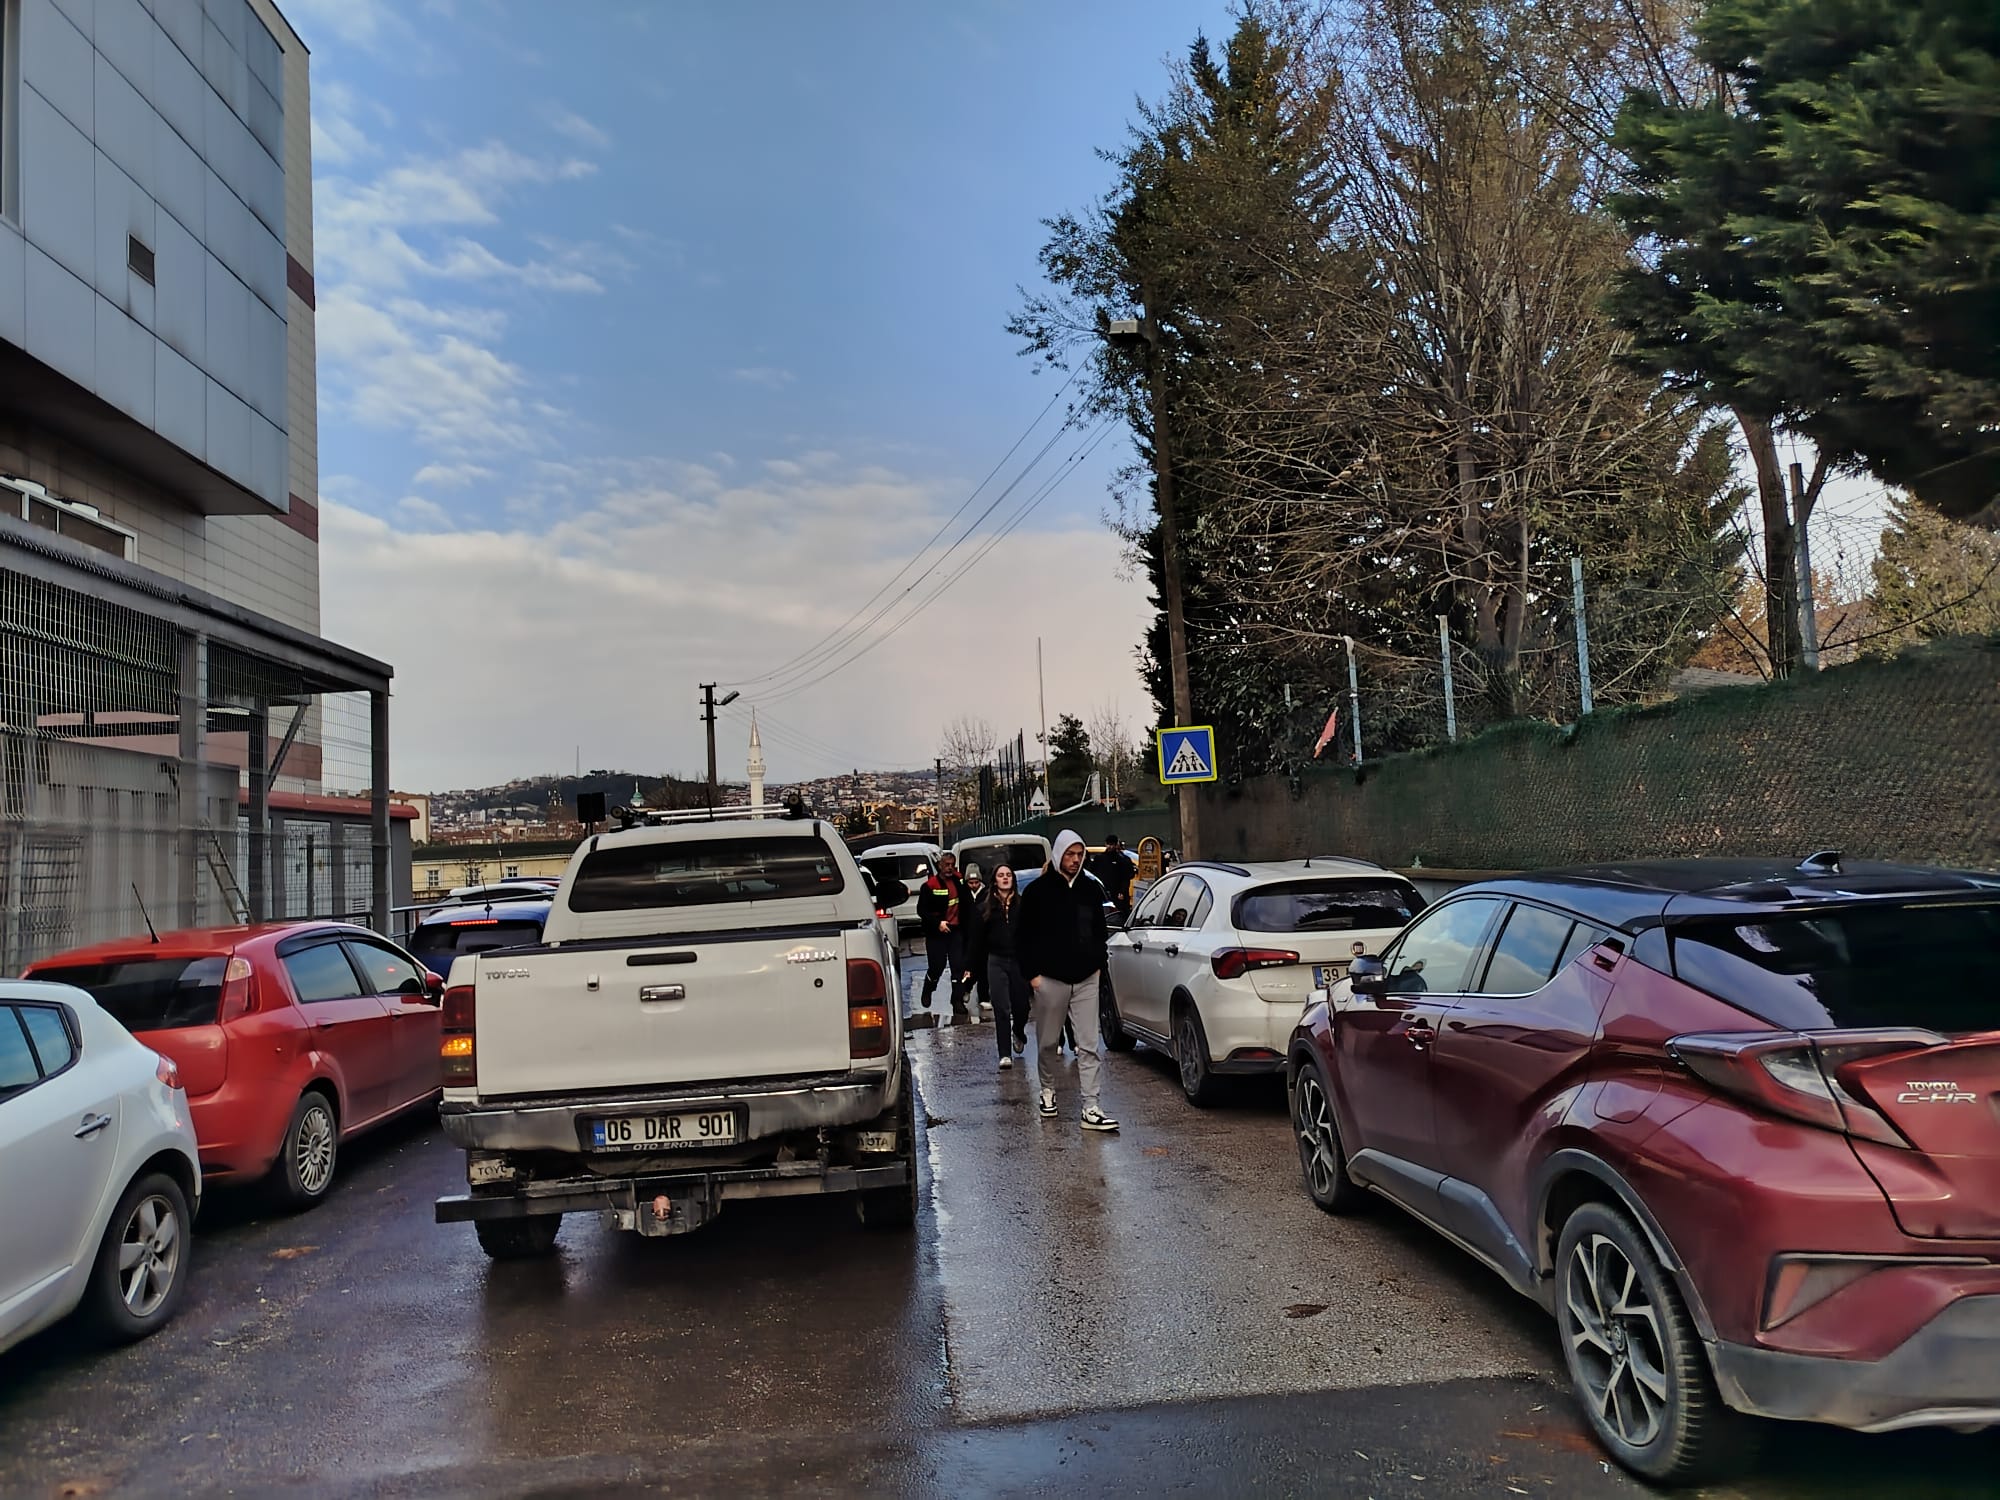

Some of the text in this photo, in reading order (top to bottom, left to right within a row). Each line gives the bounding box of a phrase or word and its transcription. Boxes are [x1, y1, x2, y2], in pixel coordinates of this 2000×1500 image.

[485, 968, 530, 980] TOYOTA
[1323, 968, 1340, 982] 39
[1906, 1081, 1960, 1092] TOYOTA
[1897, 1092, 1977, 1104] C-HR
[607, 1113, 732, 1141] 06 DAR 901
[633, 1143, 658, 1151] OTO
